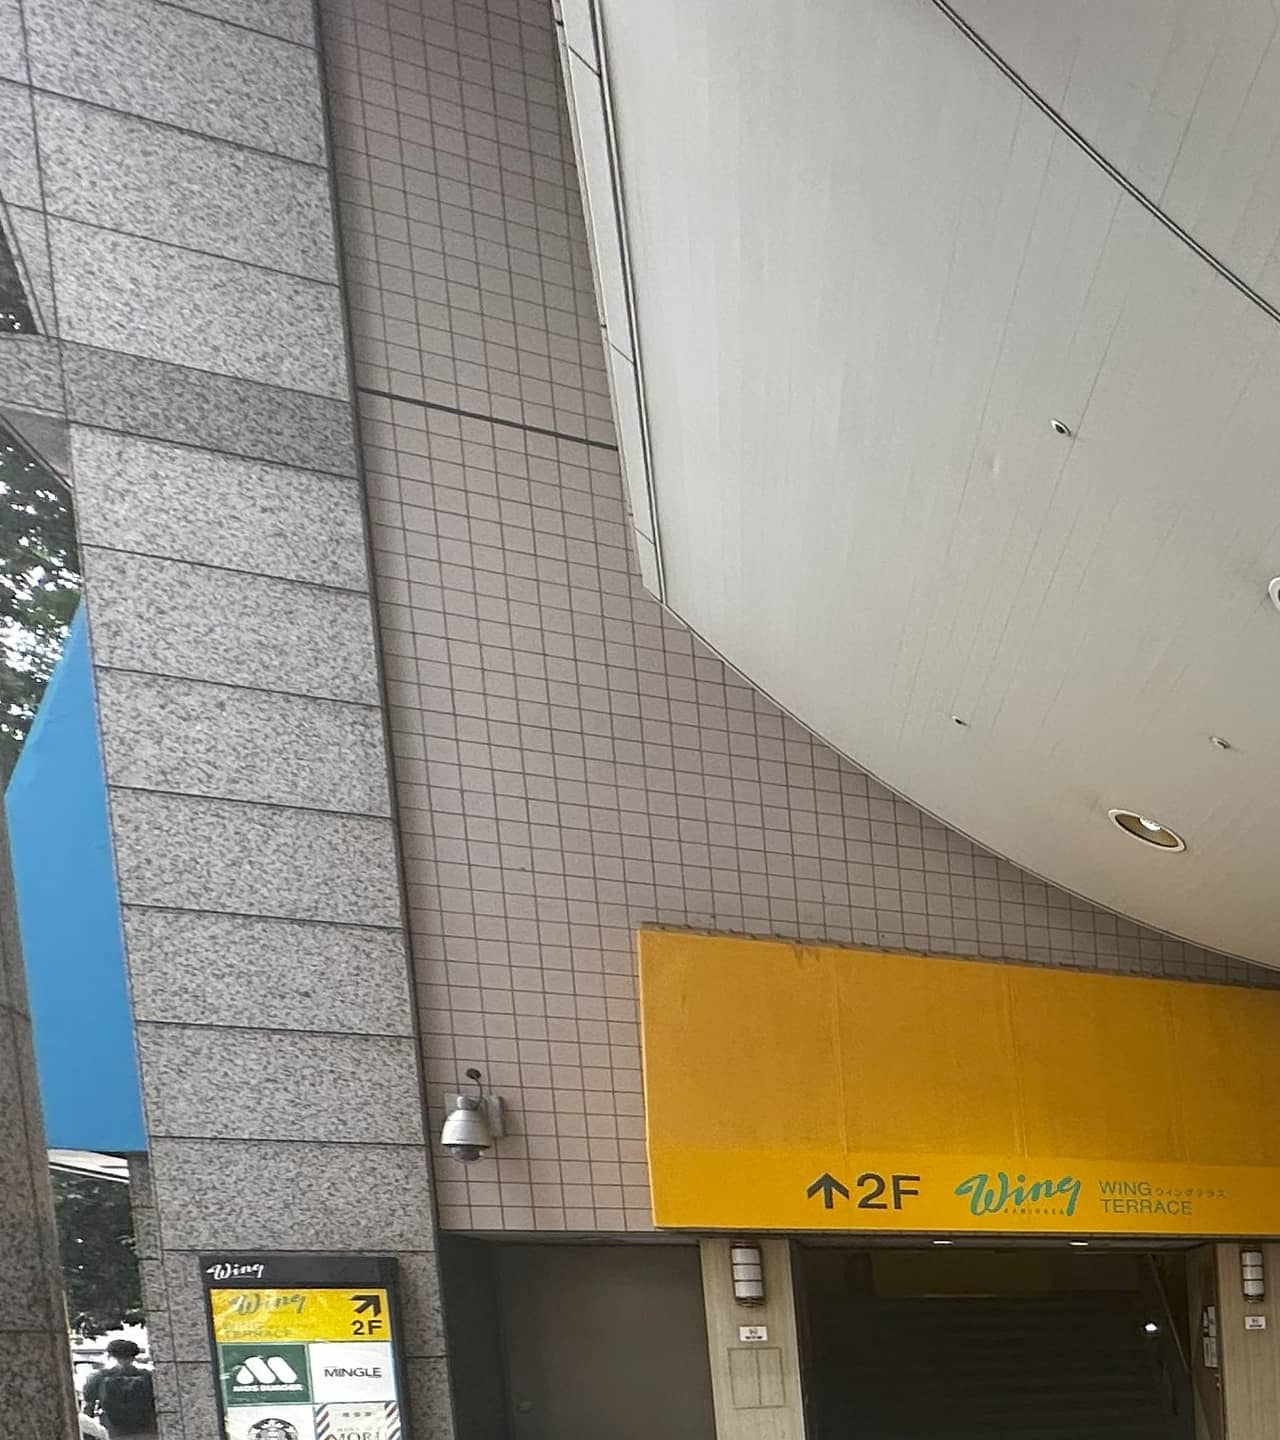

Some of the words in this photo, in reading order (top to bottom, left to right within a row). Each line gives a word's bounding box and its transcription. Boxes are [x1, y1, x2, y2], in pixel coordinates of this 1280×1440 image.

[857, 1173, 921, 1210] 2F
[954, 1172, 1082, 1217] Wing
[1099, 1179, 1152, 1197] WING
[1099, 1199, 1193, 1216] TERRACE
[206, 1263, 265, 1280] Wing
[351, 1319, 383, 1336] 2F
[324, 1367, 383, 1378] MINGLE
